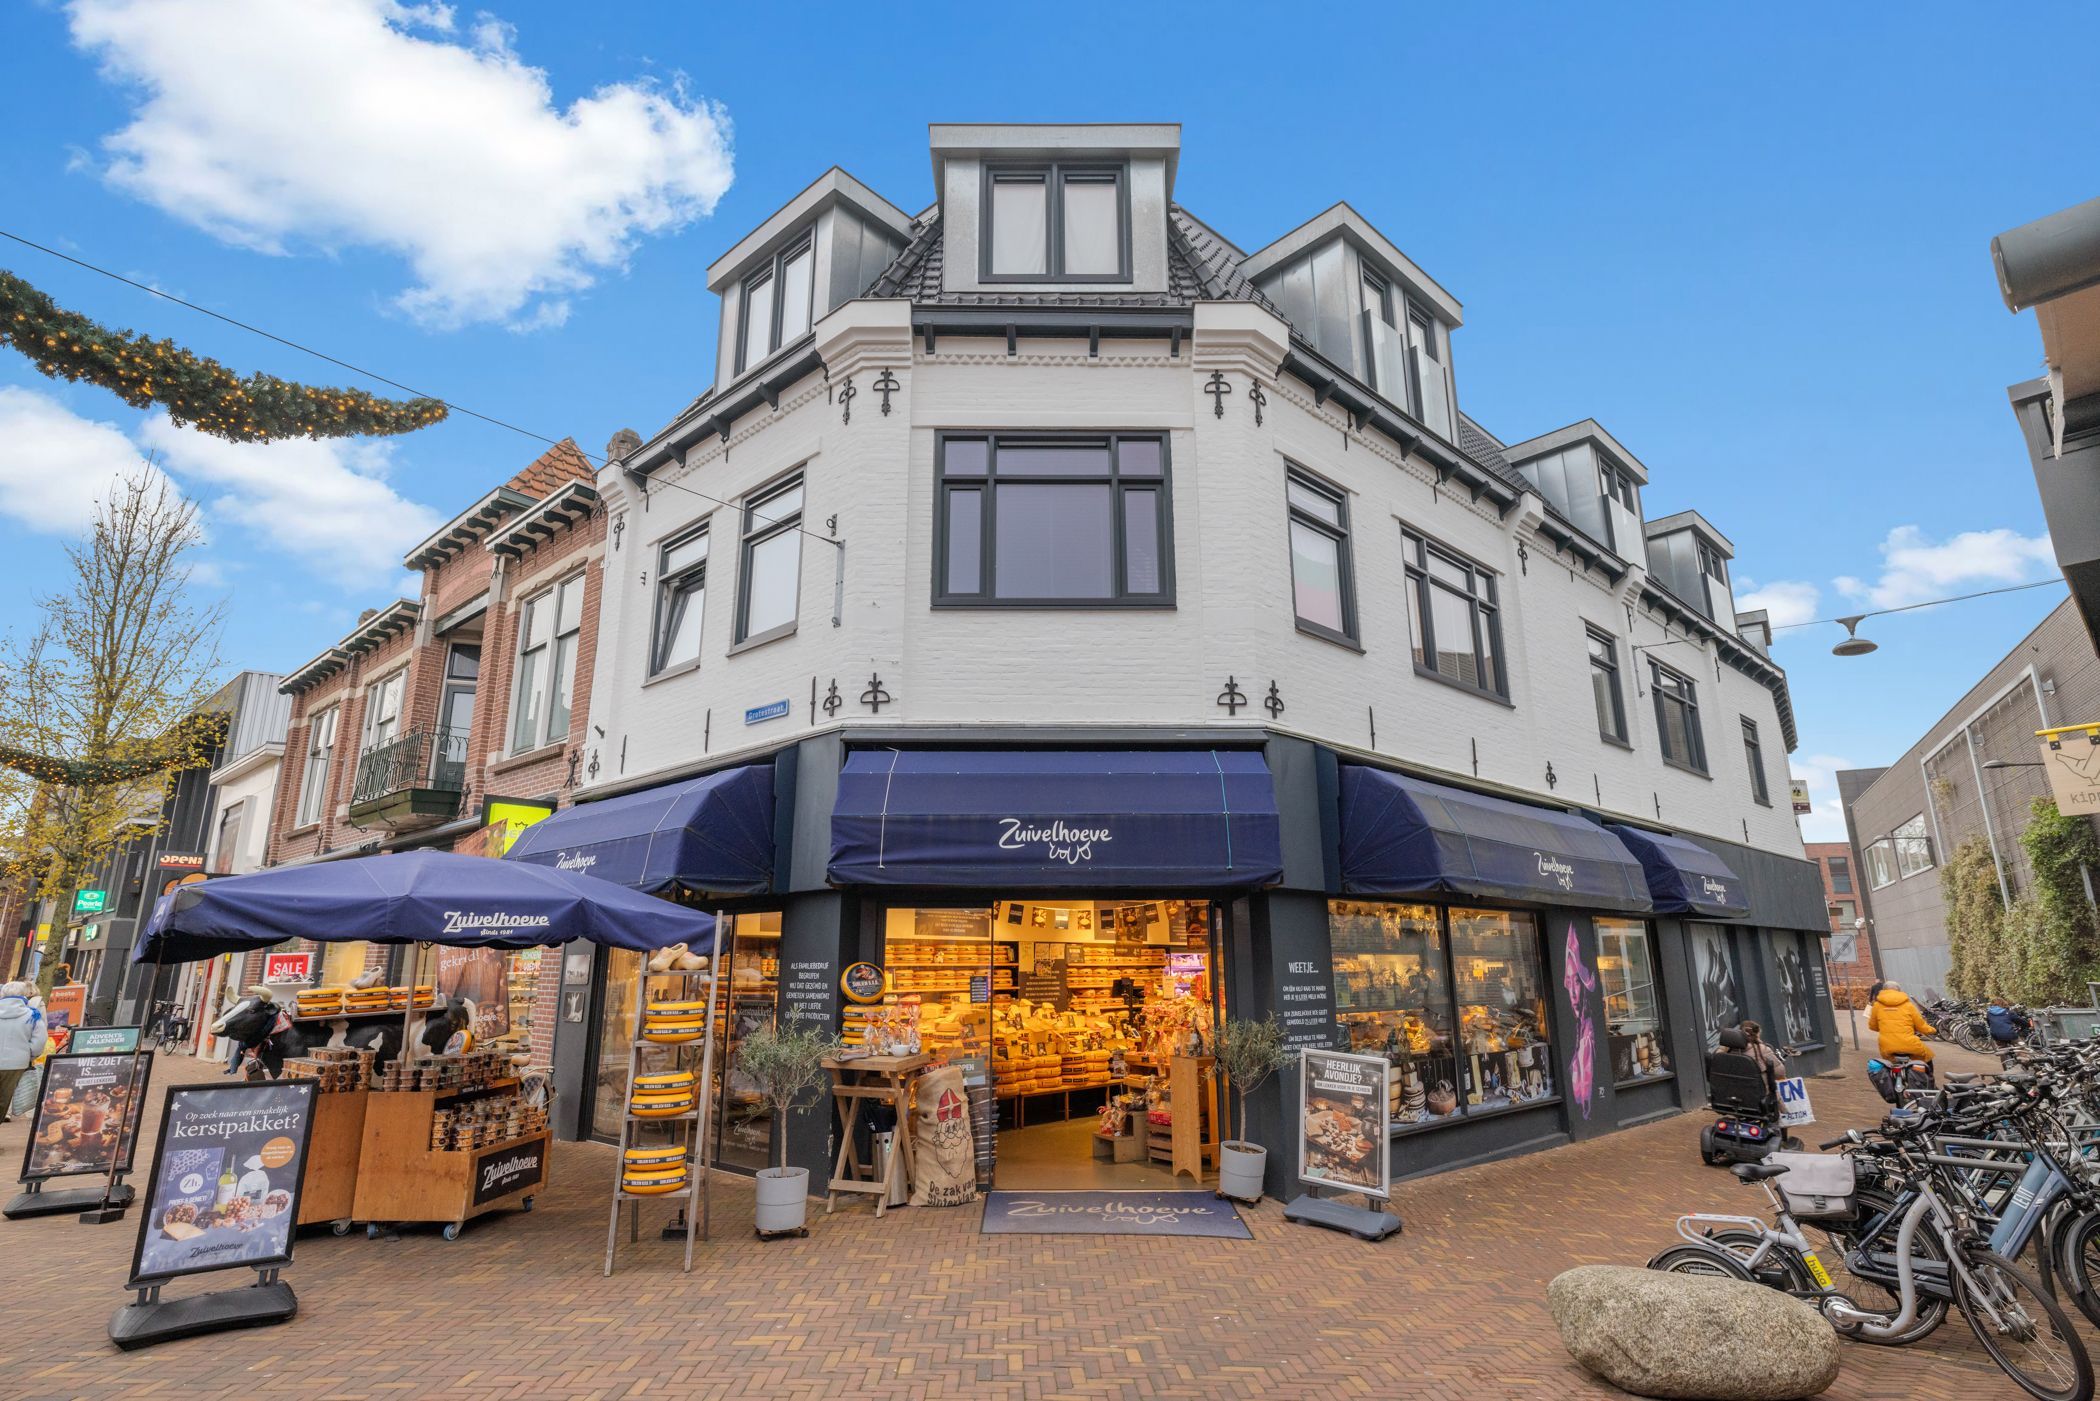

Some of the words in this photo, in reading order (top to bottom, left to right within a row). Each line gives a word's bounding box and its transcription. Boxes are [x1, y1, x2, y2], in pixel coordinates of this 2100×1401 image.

[748, 704, 784, 720] Grotestraat
[999, 818, 1112, 849] Zuivelhoeve
[556, 851, 597, 872] Zuivelhoeve
[1534, 852, 1574, 876] Zuivelhoeve
[1701, 876, 1727, 894] Zuivelhoeve
[443, 912, 550, 933] Zuivelhoeve
[273, 962, 302, 976] SALE
[78, 1058, 97, 1067] WIE
[98, 1057, 122, 1066] ZOET
[1326, 1060, 1360, 1073] HEERLIJK
[1324, 1070, 1362, 1084] AVONDJE?
[186, 1112, 198, 1122] Op
[200, 1110, 216, 1119] zoek
[218, 1109, 238, 1118] naar
[253, 1105, 288, 1116] smakelijk
[174, 1113, 300, 1139] kerstpakket?
[482, 1156, 538, 1192] Zuivelhoeve
[930, 1180, 940, 1196] De
[943, 1184, 960, 1196] zak
[962, 1178, 976, 1193] van
[1008, 1201, 1214, 1216] Zuivelhoeve
[190, 1242, 243, 1258] Zuivelhoeve
[1807, 1258, 1827, 1285] huka
